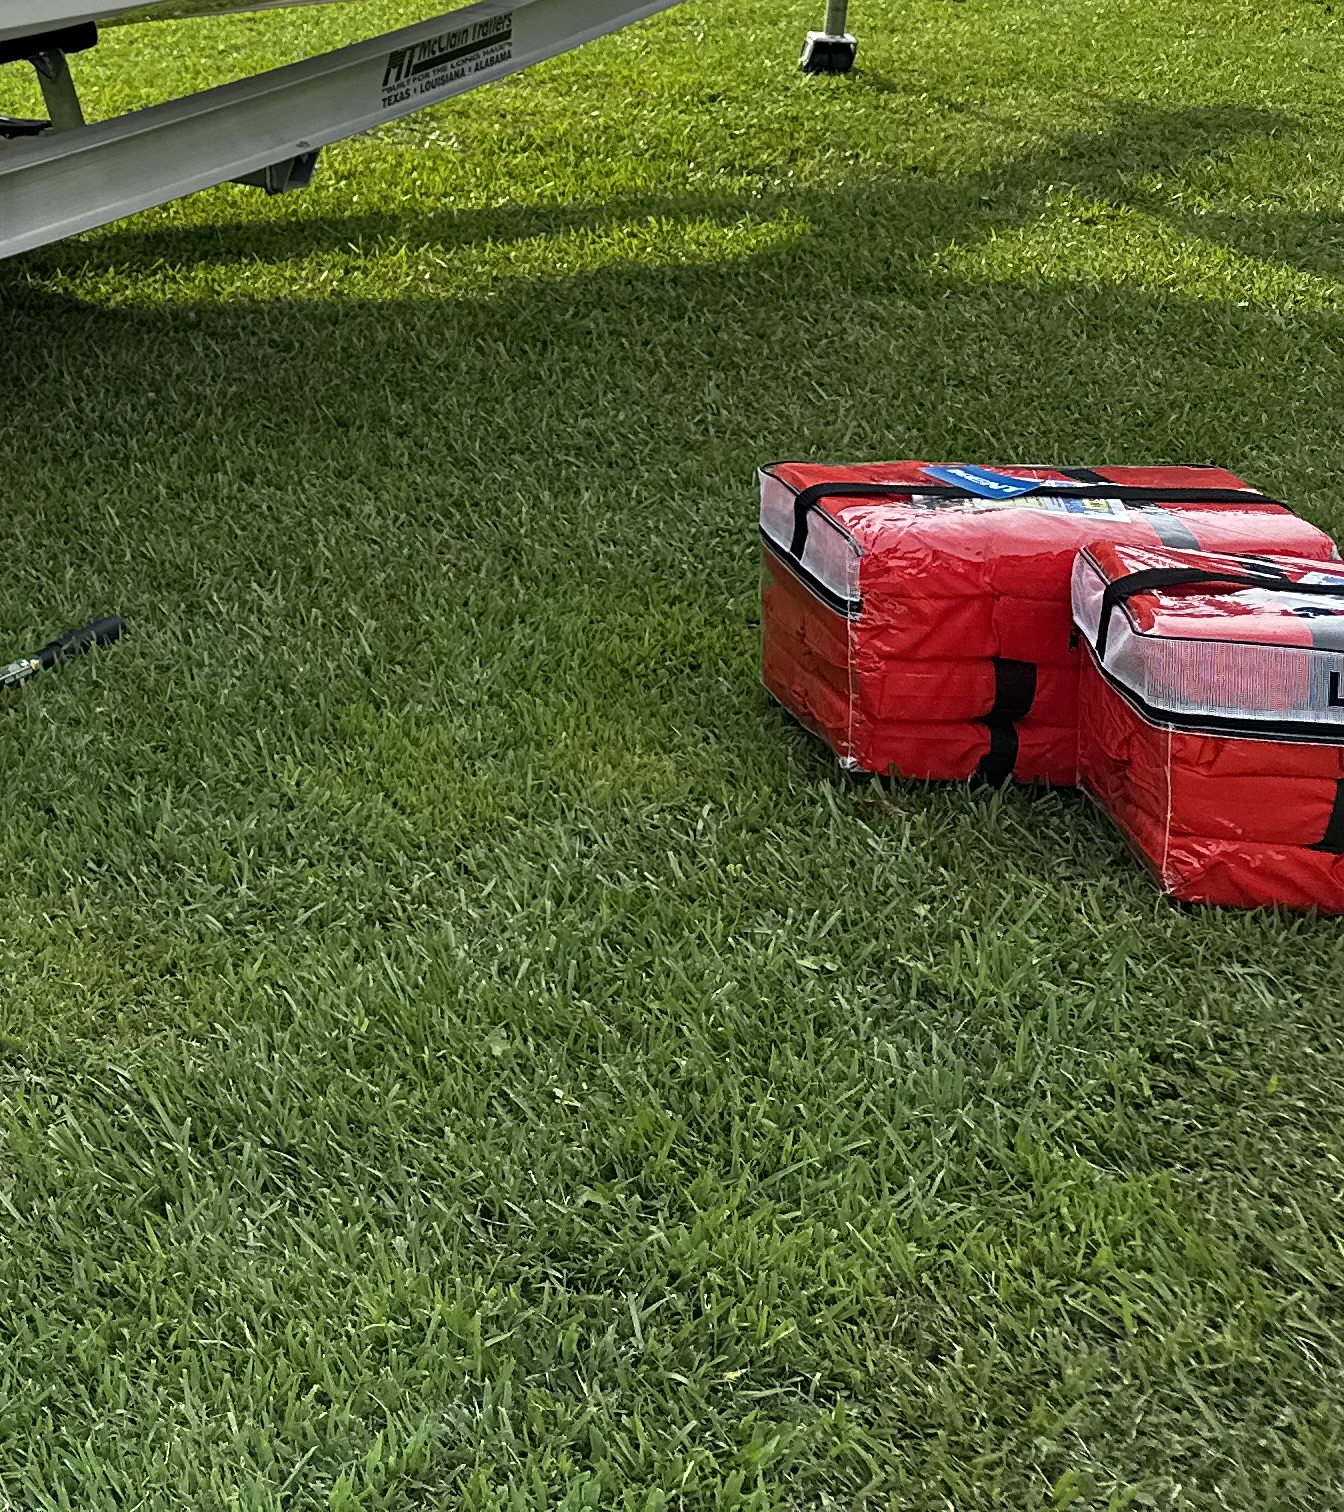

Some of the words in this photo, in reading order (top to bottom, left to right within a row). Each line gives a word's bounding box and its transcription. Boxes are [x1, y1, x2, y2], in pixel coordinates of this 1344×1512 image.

[417, 28, 469, 61] McClain
[471, 12, 512, 41] Trailers
[381, 88, 411, 109] TEXAS
[419, 67, 466, 94] LOUISIANA
[473, 49, 512, 73] ALABAMA
